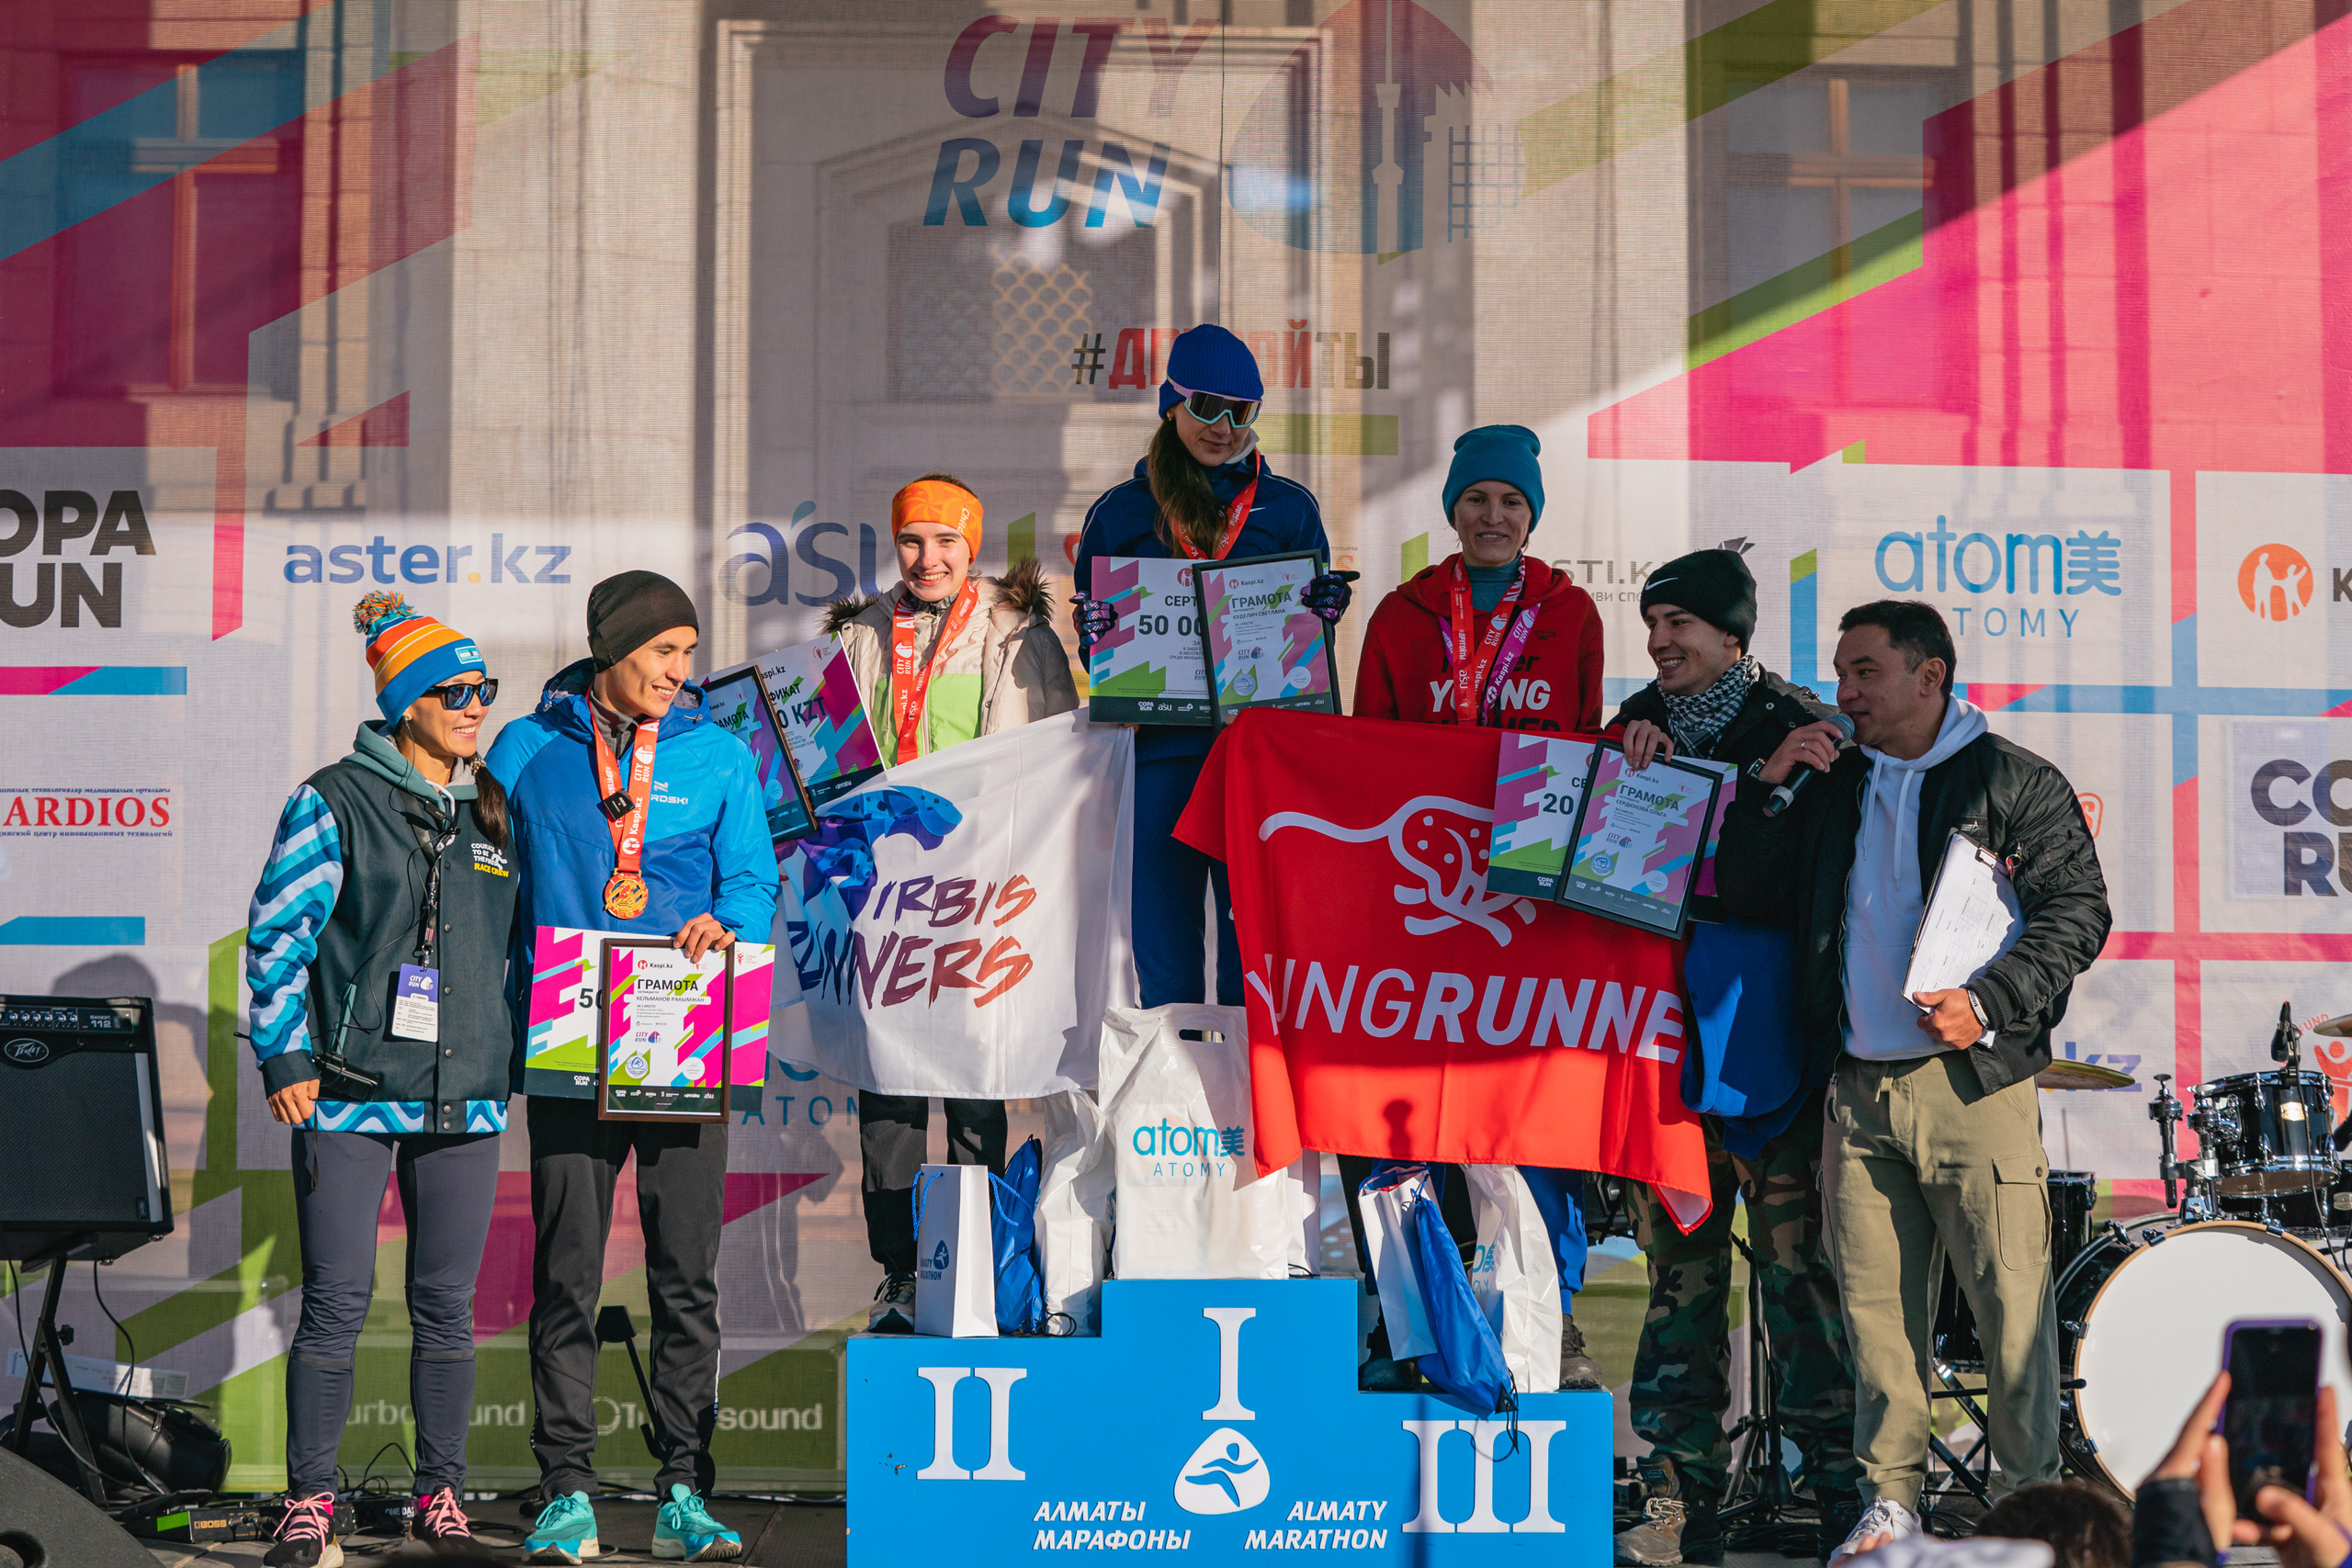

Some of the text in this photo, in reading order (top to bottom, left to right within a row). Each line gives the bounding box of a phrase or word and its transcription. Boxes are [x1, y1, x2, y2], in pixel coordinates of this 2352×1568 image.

[944, 15, 1220, 118] CITY
[922, 138, 1171, 228] RUN
[1071, 319, 1390, 389] #ДРОЙТЫ
[283, 533, 571, 584] aster.kz
[1544, 559, 1678, 584] STI.K
[1232, 592, 1293, 609] ГРАМОТА
[1138, 615, 1169, 636] 50
[1513, 621, 1525, 639] CITY
[1952, 608, 2079, 637] TOMY
[1485, 629, 1496, 645] CITY
[1491, 631, 1501, 647] RUN
[1519, 628, 1529, 644] RUN
[761, 665, 786, 680] aspi.kz
[897, 659, 905, 675] CITY
[1495, 651, 1514, 686] Kaspi.kz
[1430, 678, 1551, 712] YNG
[791, 696, 826, 725] KZT
[634, 763, 643, 782] CITY
[642, 766, 650, 783] RUN
[1636, 773, 1659, 784] Kaspi.kz
[1543, 793, 1574, 815] 20
[1620, 784, 1679, 811] ГРАМОТА
[3, 796, 170, 827] ARDIOS
[629, 797, 643, 835] Kaspi.kz
[1616, 799, 1649, 813] СЕРДЮКОВА
[1649, 809, 1667, 818] ОЛЬГА
[474, 862, 491, 874] RACE
[410, 975, 422, 983] CITY
[638, 979, 698, 991] ГРАМОТА
[1153, 1162, 1225, 1178] ATOMY
[1203, 1307, 1256, 1421] I
[917, 1367, 1028, 1480] II
[1401, 1420, 1566, 1534] III
[1033, 1501, 1146, 1521] АЛМАТЫ
[1285, 1501, 1387, 1521] ALMATY
[200, 1519, 227, 1529] BOSS
[1033, 1529, 1191, 1550] МАРАФОНЫ
[1244, 1529, 1387, 1550] MARATHON
